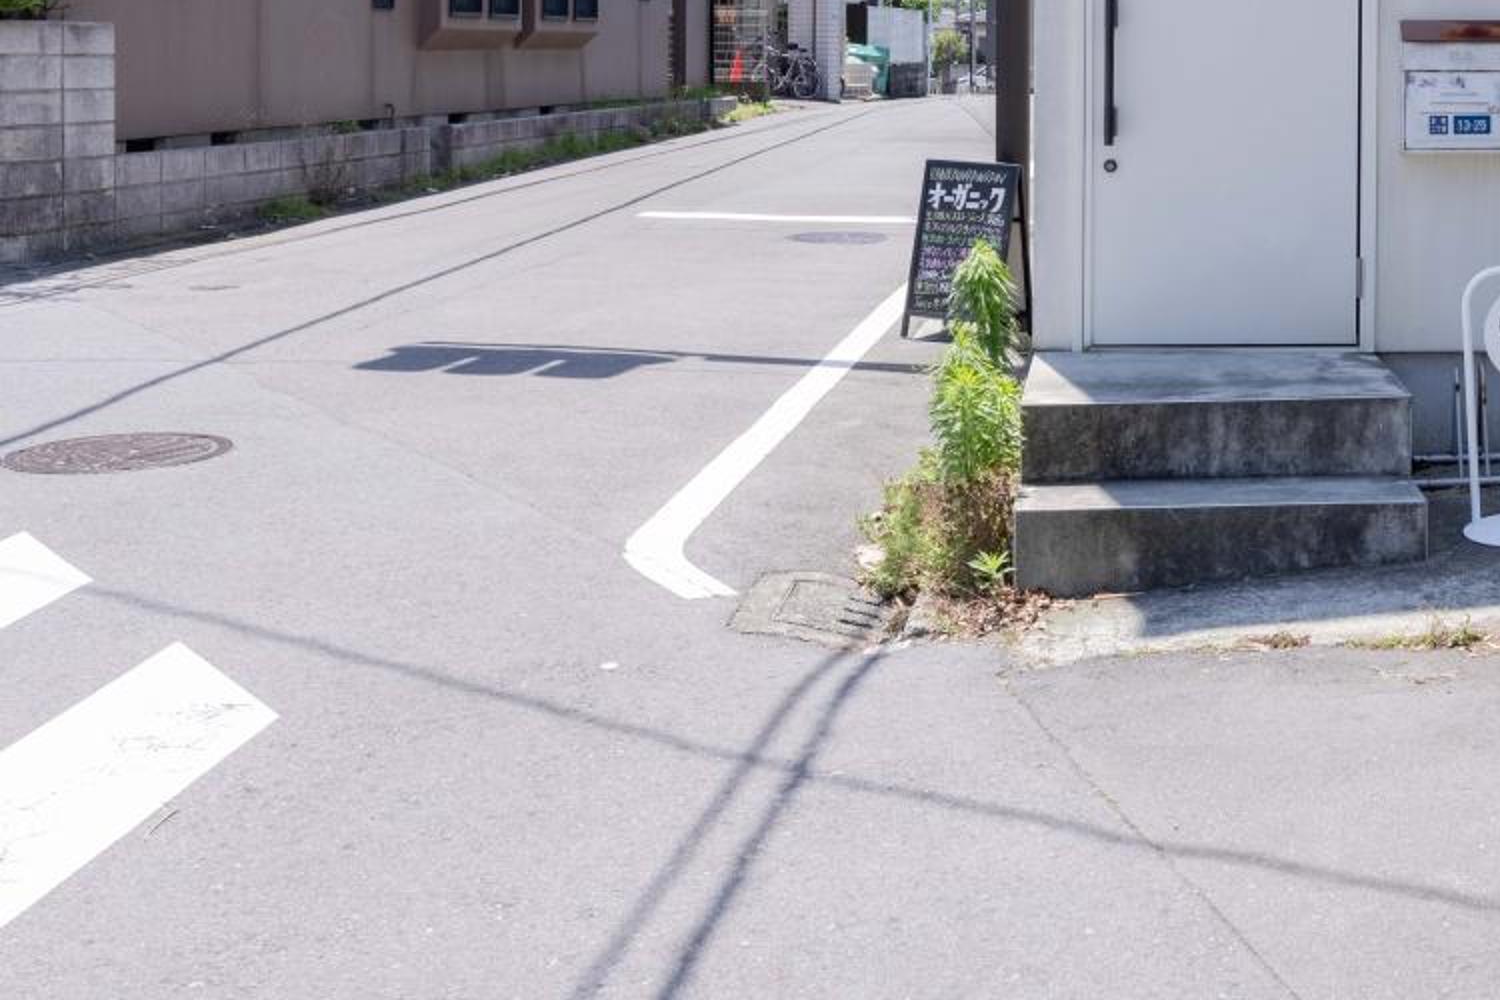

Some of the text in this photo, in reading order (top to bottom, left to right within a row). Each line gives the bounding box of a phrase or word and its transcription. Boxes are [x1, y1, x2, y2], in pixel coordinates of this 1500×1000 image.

[927, 182, 1006, 213] オーガニック
